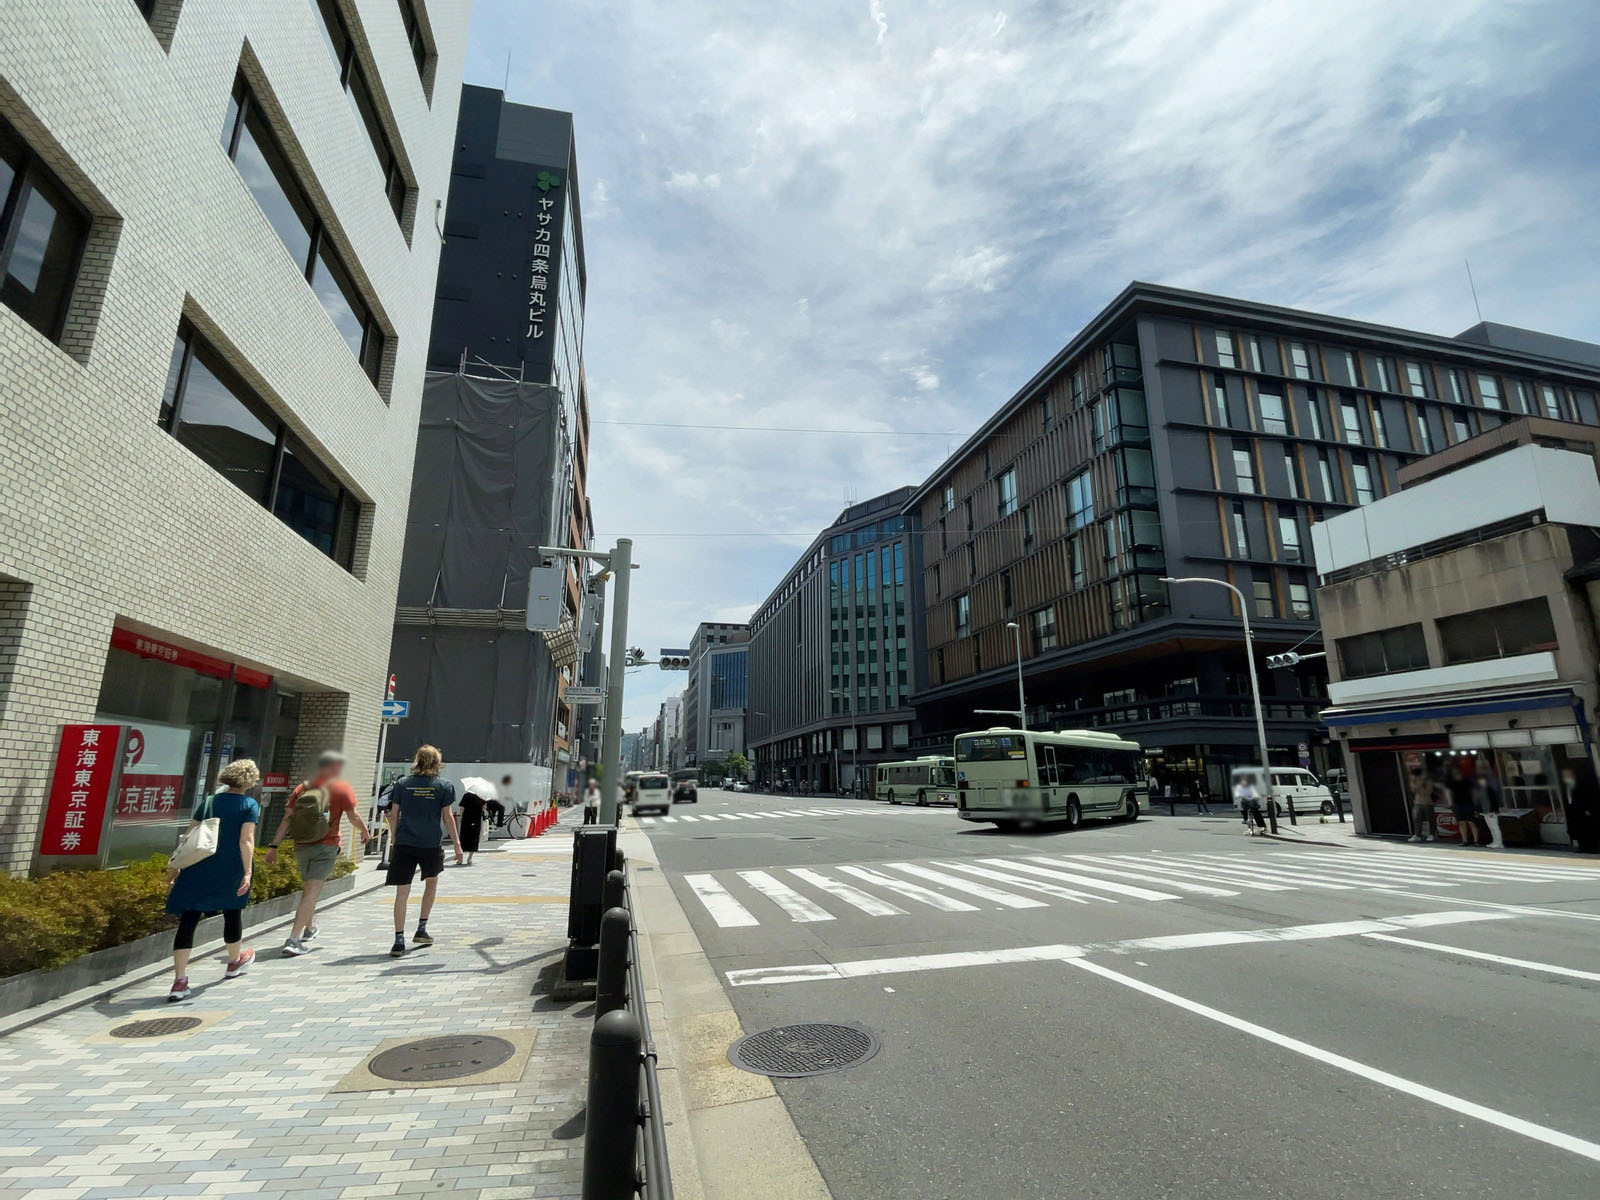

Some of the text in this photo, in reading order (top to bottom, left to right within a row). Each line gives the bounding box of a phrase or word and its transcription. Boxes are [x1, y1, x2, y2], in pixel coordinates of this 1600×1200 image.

[526, 197, 554, 339] ヤサカ四条烏丸ビル
[60, 729, 101, 850] 東海東京証券
[115, 785, 176, 815] 京証券
